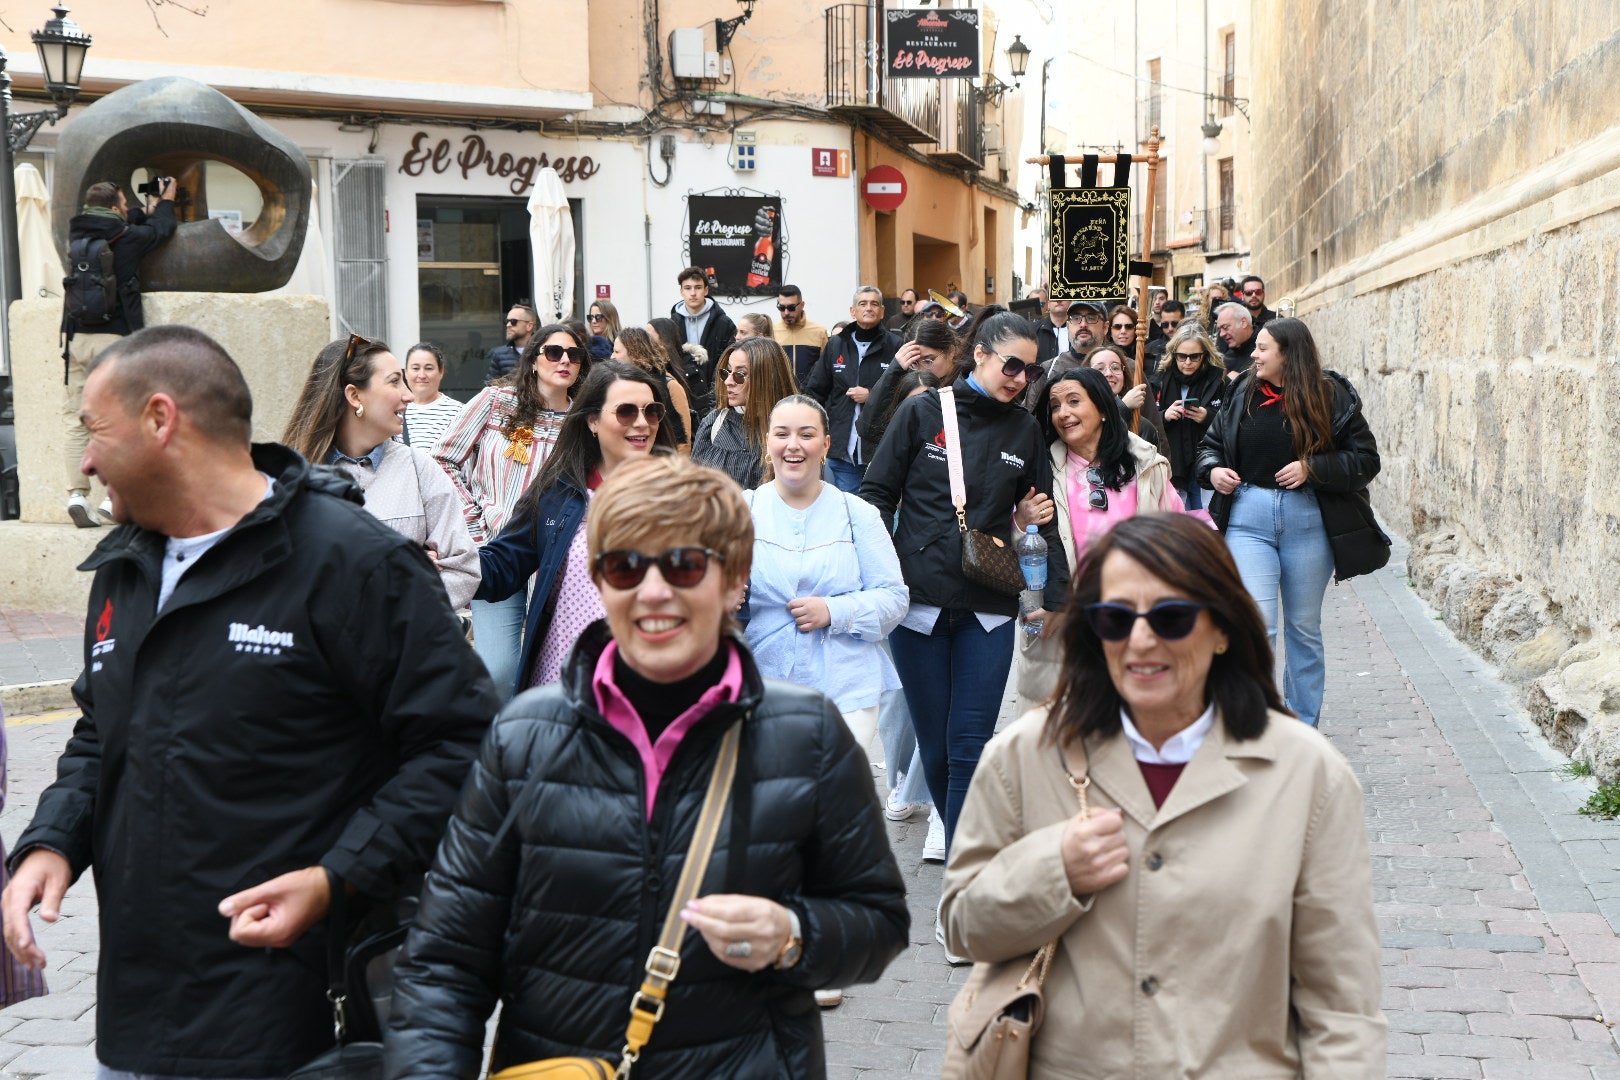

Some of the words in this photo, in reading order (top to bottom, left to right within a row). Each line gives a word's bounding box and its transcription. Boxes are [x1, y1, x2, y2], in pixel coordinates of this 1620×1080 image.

[893, 49, 914, 69] El
[915, 49, 972, 75] Progreso
[399, 131, 452, 177] El
[456, 134, 600, 195] Progreso
[695, 219, 710, 234] El
[711, 219, 752, 238] Progreso
[701, 238, 746, 247] BAR-RESTAURANTE
[228, 621, 295, 648] Mahou
